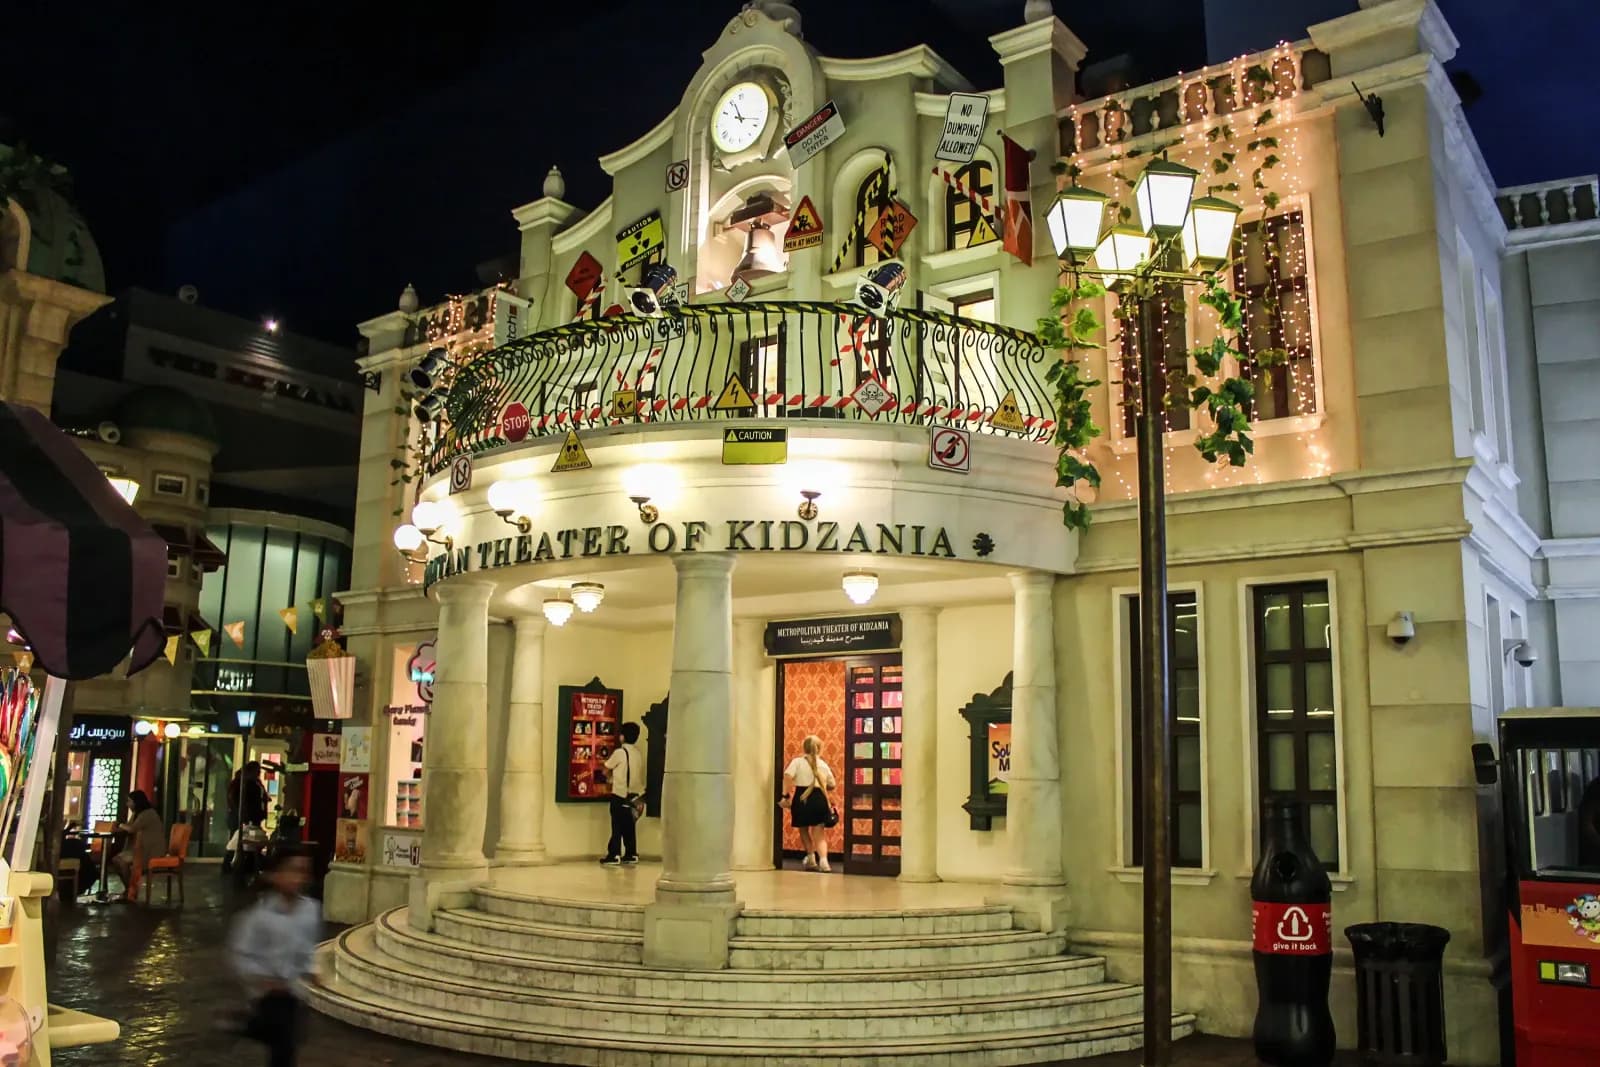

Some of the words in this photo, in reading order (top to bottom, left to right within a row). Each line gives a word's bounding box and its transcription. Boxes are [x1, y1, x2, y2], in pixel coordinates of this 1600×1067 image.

[961, 104, 972, 117] NO
[796, 115, 823, 138] DANGER
[947, 122, 979, 137] DUMPING
[802, 138, 813, 149] DO
[814, 126, 828, 140] NOT
[807, 136, 829, 154] ENTER
[940, 140, 974, 155] ALLOWED
[622, 216, 652, 237] CAUTION
[881, 214, 904, 228] RAD
[785, 240, 797, 249] MEN
[798, 239, 805, 247] AT
[805, 235, 821, 245] WORK
[503, 415, 528, 431] STOP
[738, 431, 772, 440] CAUTION
[477, 525, 630, 569] THEATER
[648, 521, 706, 552] OF
[725, 520, 957, 557] KIDZANIA
[777, 625, 821, 637] METROPOLITAN
[822, 623, 849, 634] THEATER
[850, 622, 859, 632] OF
[859, 621, 889, 632] KIDZANIA
[87, 728, 125, 739] سويس
[999, 758, 1010, 772] M
[1273, 943, 1289, 951] give
[1299, 942, 1317, 950] back
